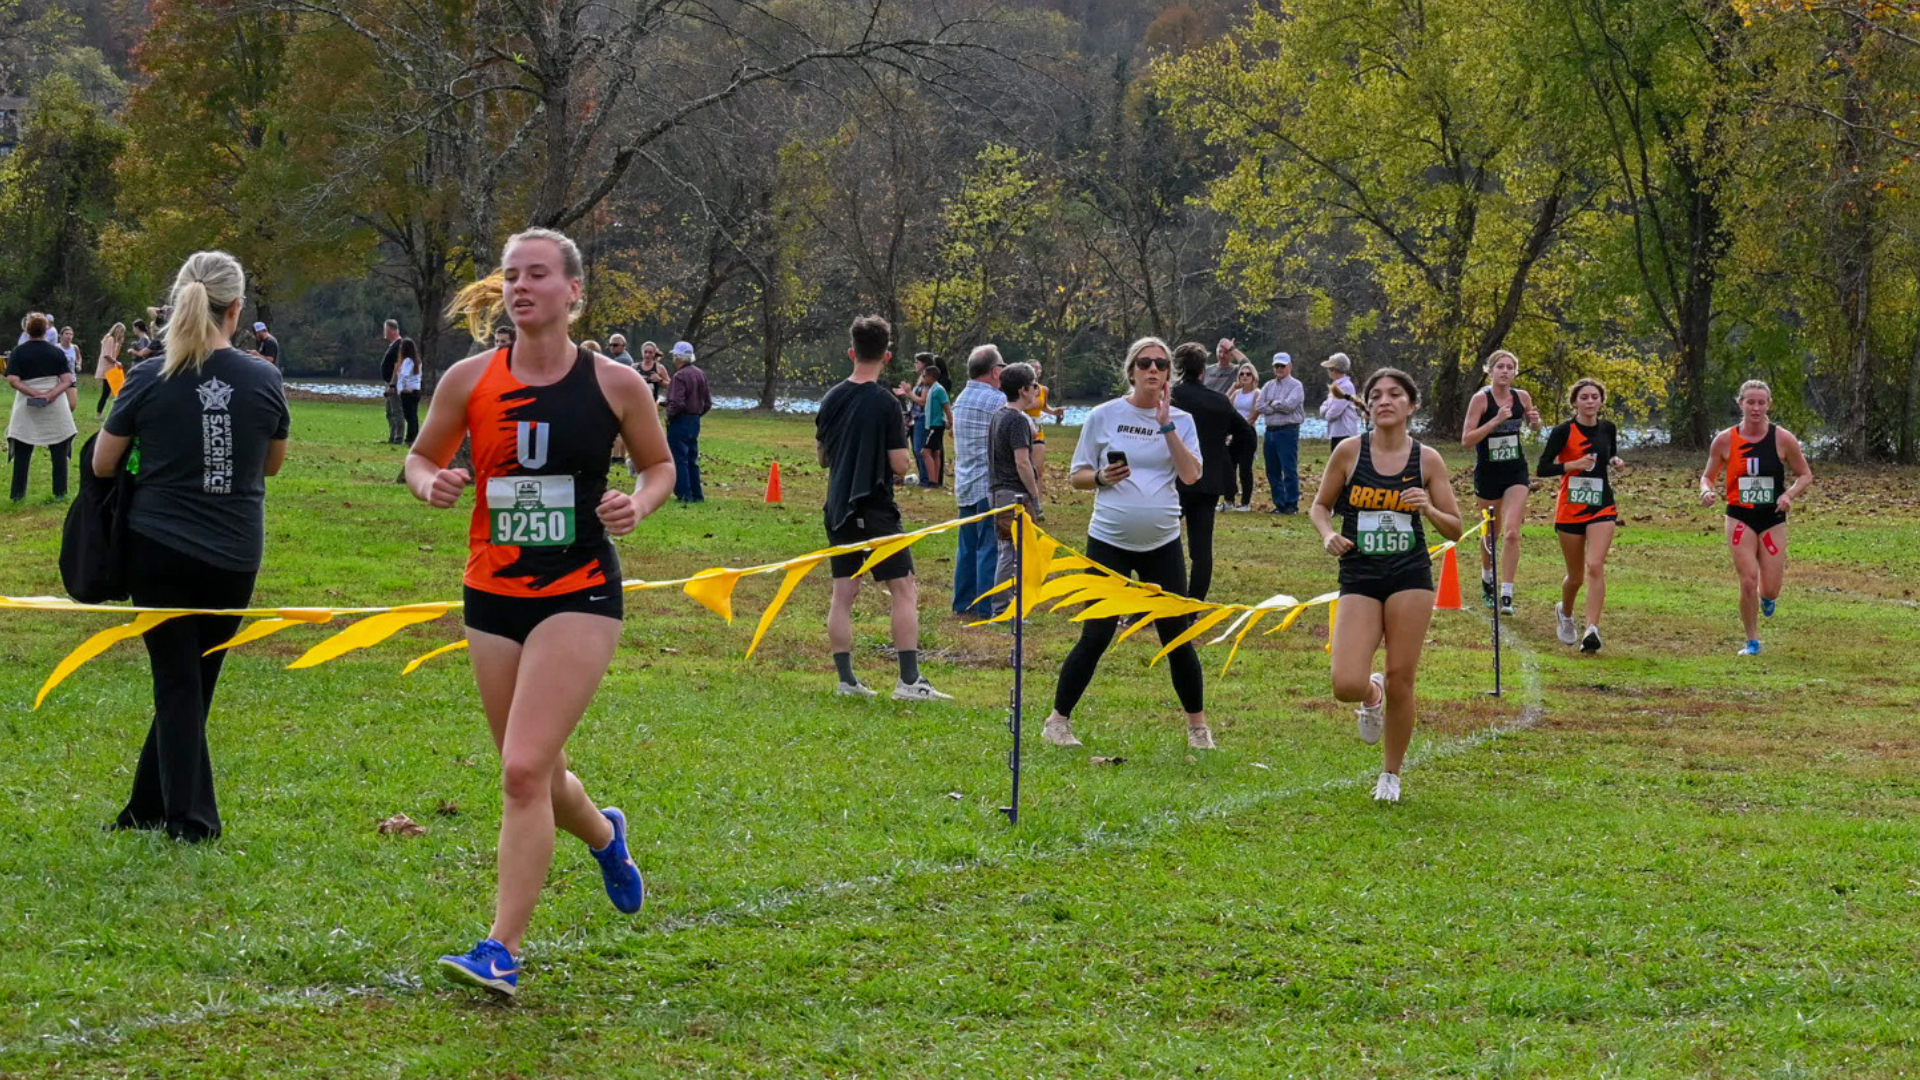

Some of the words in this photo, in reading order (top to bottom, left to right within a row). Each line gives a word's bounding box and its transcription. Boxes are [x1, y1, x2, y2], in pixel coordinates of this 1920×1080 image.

[202, 414, 211, 455] MEMORIES
[224, 414, 233, 458] GRATEFUL
[1117, 424, 1154, 436] BRENAU
[517, 421, 549, 469] U
[1492, 447, 1516, 460] 9234
[204, 456, 211, 468] OF
[210, 415, 225, 494] SACRIFICE
[225, 460, 233, 477] FOR
[1746, 458, 1759, 475] U
[224, 479, 232, 495] THE
[1570, 490, 1600, 504] 9246
[1742, 490, 1771, 503] 9249
[498, 511, 566, 541] 9250
[1364, 532, 1409, 552] 9156
